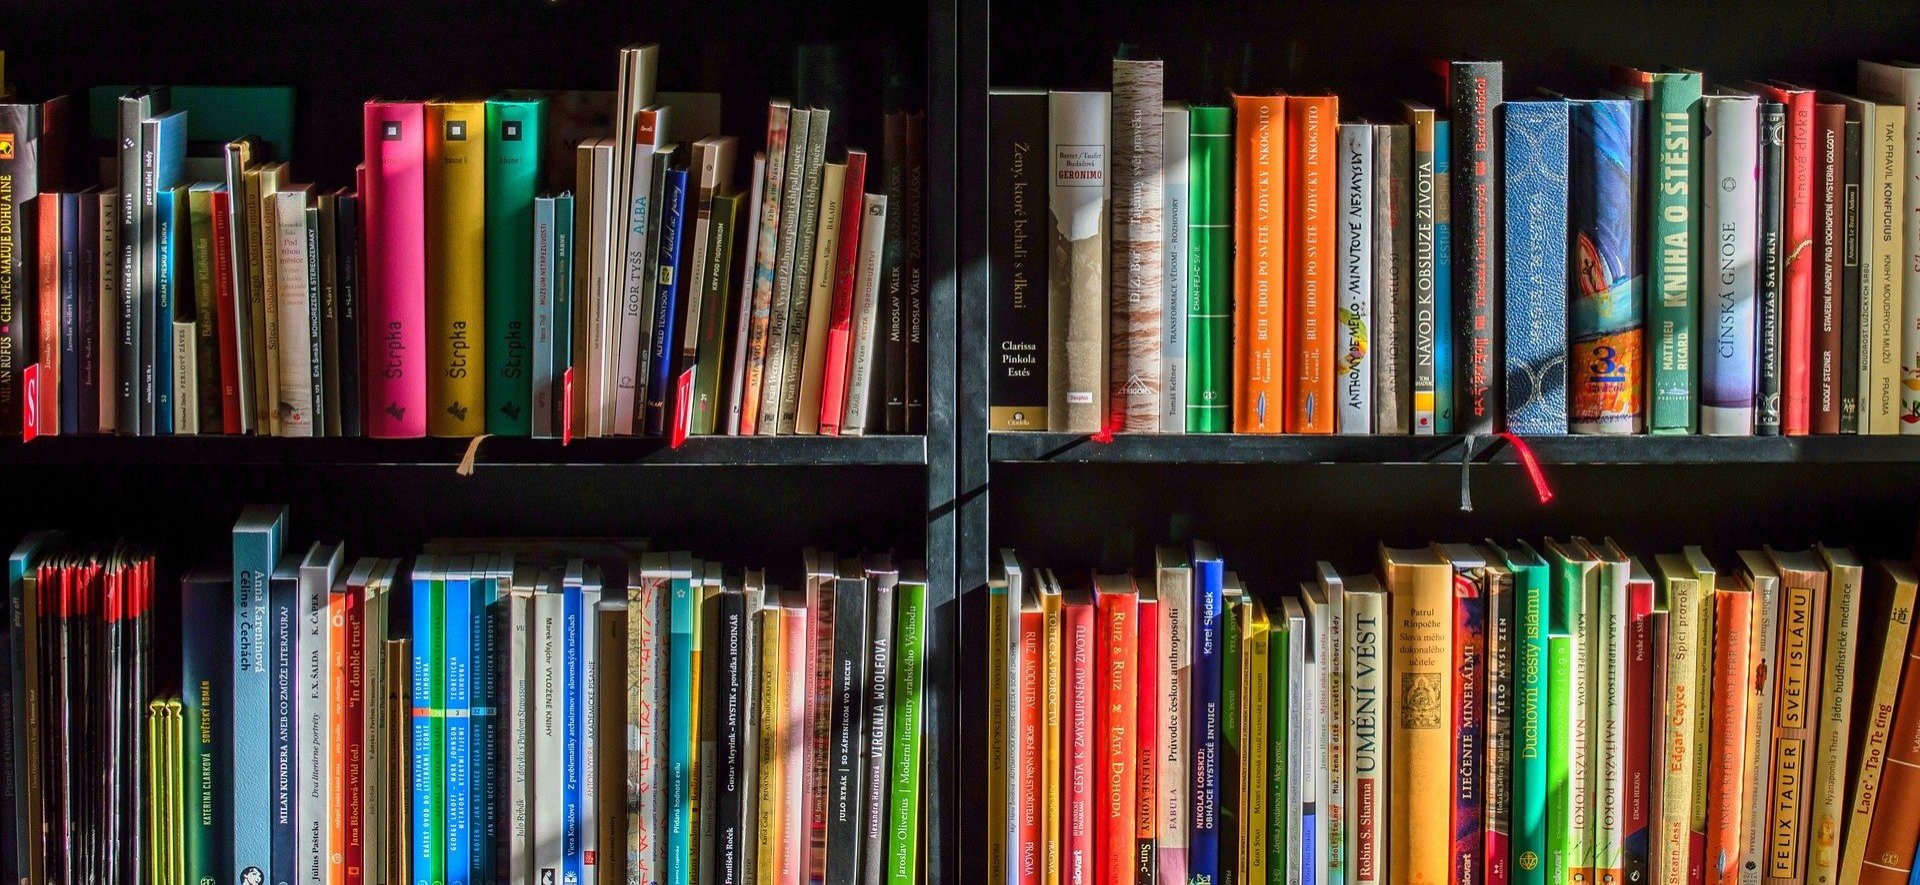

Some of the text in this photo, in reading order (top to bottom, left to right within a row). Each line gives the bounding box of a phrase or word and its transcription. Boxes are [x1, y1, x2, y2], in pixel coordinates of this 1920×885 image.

[1885, 123, 1894, 142] TAK
[1011, 142, 1030, 178] Ženy,
[1058, 170, 1102, 180] GERONIMO
[1884, 144, 1893, 179] PRAVIL
[124, 193, 132, 224] Pazúrik
[1014, 182, 1028, 217] ktoré
[1659, 112, 1689, 308] KNIHA O ŠTĚSTÍ
[1883, 182, 1892, 241] KONFUCIUS
[160, 222, 168, 245] BÚRKA
[1014, 219, 1028, 259] behali
[1257, 105, 1269, 340] BŮH CHODÍ PO SVĚTĚ VŽDYCKY INKOGNITO
[103, 203, 112, 290] PÍSEŇ PÍSNÍ
[161, 246, 168, 254] JE
[628, 197, 647, 316] IGOR TYŠŠ ALBA
[1416, 162, 1432, 366] NÁVOD K OBSLUZE ŽIVOTA
[1014, 272, 1028, 309] vlkmi
[1718, 222, 1735, 358] ČÍNSKÁ GNOSE
[1822, 129, 1835, 412] RUDOLF STEINER STAVEBNÍ KAMENY PRO POCHOPENÍ MYSTERIA GOLGOTY
[160, 286, 168, 307] CHRÁM
[890, 266, 901, 342] MIROSLAV VÁLEK
[1764, 232, 1776, 378] FRATERNITAS SATURNI
[1882, 284, 1892, 336] MOUDRÝCH
[124, 321, 132, 345] James
[655, 290, 668, 358] ALFRED TENNYSON
[772, 310, 786, 336] Plop!
[381, 322, 403, 379] Štrpka
[445, 321, 467, 378] Štrpka
[499, 321, 522, 378] Štrpka
[768, 342, 780, 384] Wernisch
[1002, 341, 1036, 351] Clarissa
[1002, 354, 1035, 364] Pinkola
[1663, 321, 1674, 370] MATTHIEU
[1677, 333, 1688, 370] RICARD
[1882, 338, 1892, 364] MUŽŮ
[1008, 366, 1030, 377] Estés
[27, 378, 36, 426] S
[766, 385, 776, 405] Ivan
[1881, 377, 1890, 415] PRAGMA
[240, 570, 251, 607] Céline
[254, 570, 265, 673] Anna Kareninová
[310, 594, 319, 624] ČAPEK
[1203, 592, 1214, 654] Karel Sládek
[1410, 608, 1434, 616] Patrul
[240, 621, 254, 671] Čechách
[311, 626, 319, 635] K.
[1072, 625, 1086, 663] ŽIVOTU
[1113, 646, 1123, 654] &
[1399, 645, 1445, 655] dokonalého
[1400, 632, 1444, 641] Slova mého
[310, 650, 319, 679] ŠALDA
[1409, 657, 1435, 666] učitele
[1521, 589, 1542, 759] Duchovní cesty islámu
[311, 680, 319, 690] X.
[1824, 583, 1852, 805] Nyanaponika Théra Jádro buddhistické meditace
[278, 607, 289, 824] MILAN KUNDERA ANEB CO ZMŮŽE LITERATURA?
[1073, 668, 1085, 747] ZMYSLUPLNÉMU
[1459, 645, 1474, 798] LIEČENIE MINERÁLMI
[311, 712, 321, 744] portréty
[349, 615, 361, 846] Jana Bžochová-Wild (ed.) “In double trust”
[870, 638, 886, 839] Alexandra Harrisová VIRGINIA WOOLFOVÁ
[896, 606, 916, 879] Jaroslav Oliverius Moderní literatury arabského Východu
[1351, 613, 1376, 876] Robin S. Sharma UMĚNÍ VÉST
[1670, 589, 1688, 884] Stearn Jess Edgar Cayce Spící prorok
[1776, 595, 1806, 869] FELIX TAUER SVĚT ISLÁMU
[200, 680, 212, 825] KATERINA CLARKOVÁ SOVĚTSKÝ ROMÁN
[311, 746, 320, 782] literárne
[1197, 748, 1205, 788] LOSSKIJ:
[1206, 742, 1214, 786] MYSTICKÉ
[311, 783, 320, 798] Dva
[1074, 762, 1084, 793] CESTA
[1205, 789, 1214, 829] OBHÁJCE
[311, 821, 320, 854] Pašteka
[310, 855, 320, 881] Július
